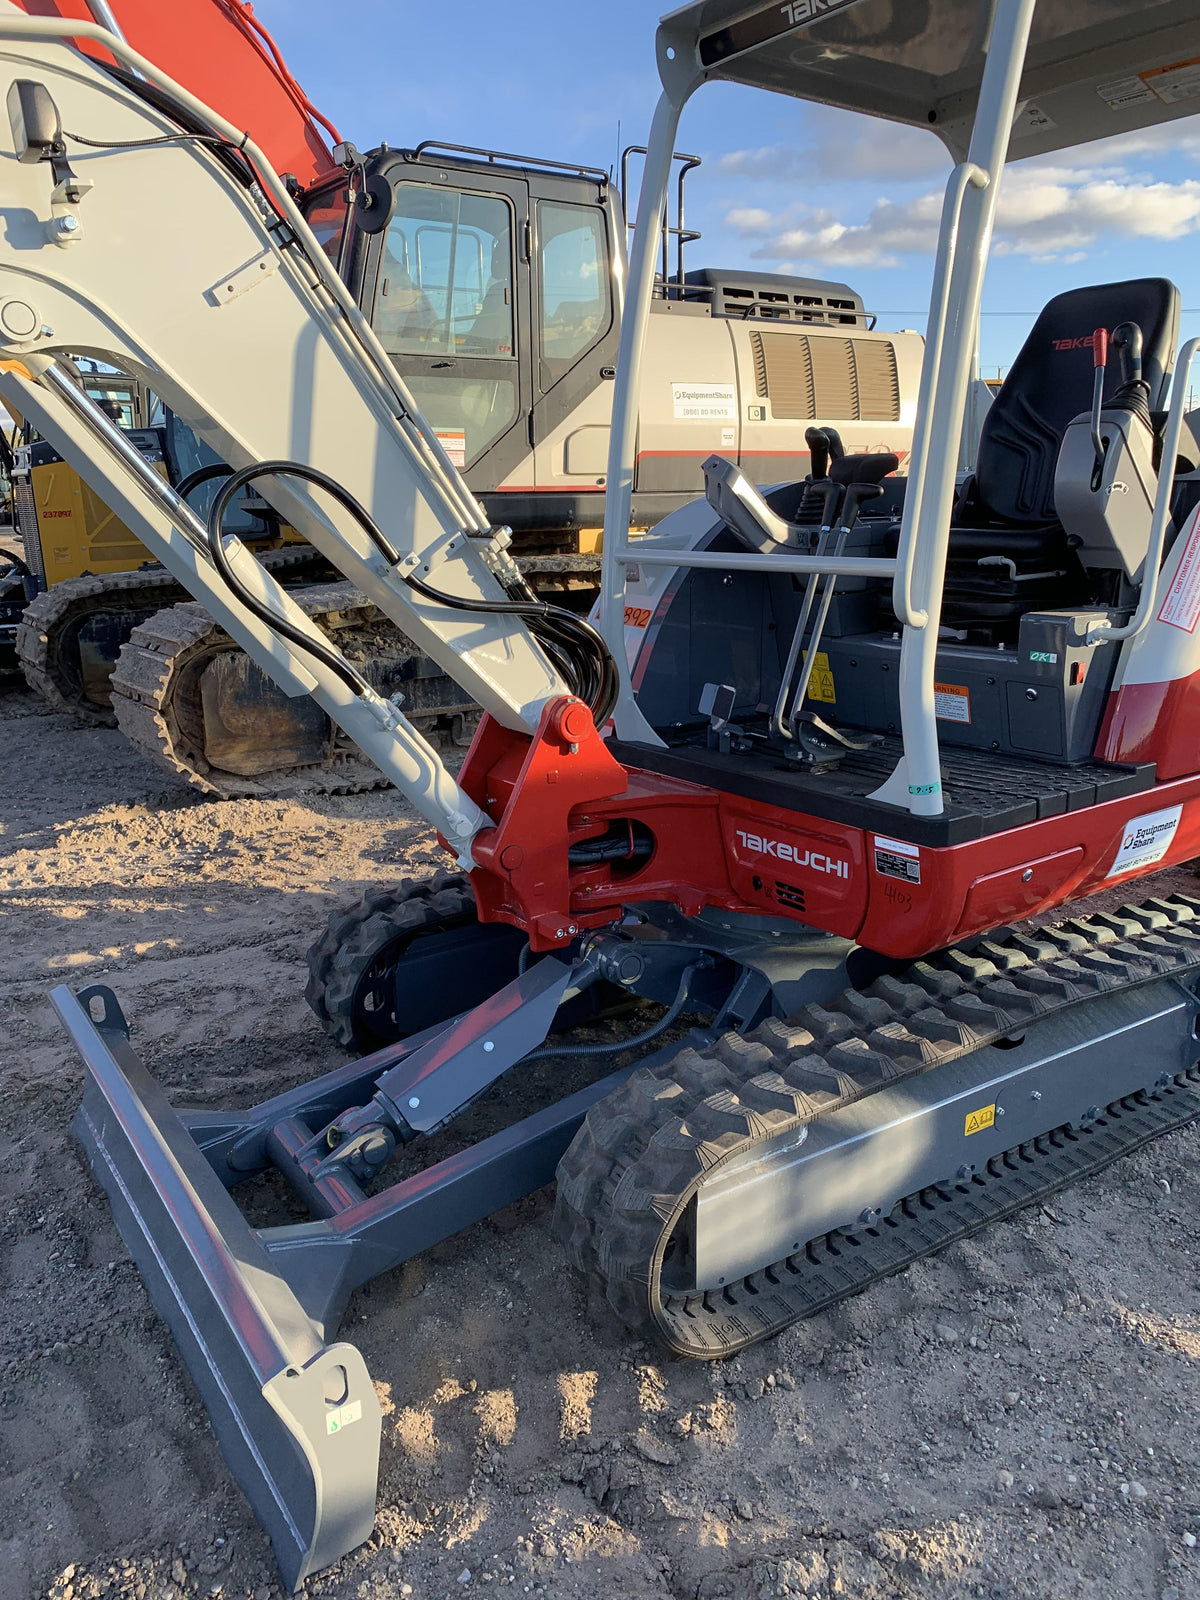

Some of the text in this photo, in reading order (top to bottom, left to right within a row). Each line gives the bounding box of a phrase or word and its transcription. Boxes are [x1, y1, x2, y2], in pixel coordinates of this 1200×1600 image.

[682, 392, 733, 400] EquipmentShare
[1174, 558, 1191, 594] CUSTOMER
[1136, 819, 1177, 839] Equipment
[1132, 837, 1155, 850] Share
[736, 830, 848, 879] TAKEUCHI
